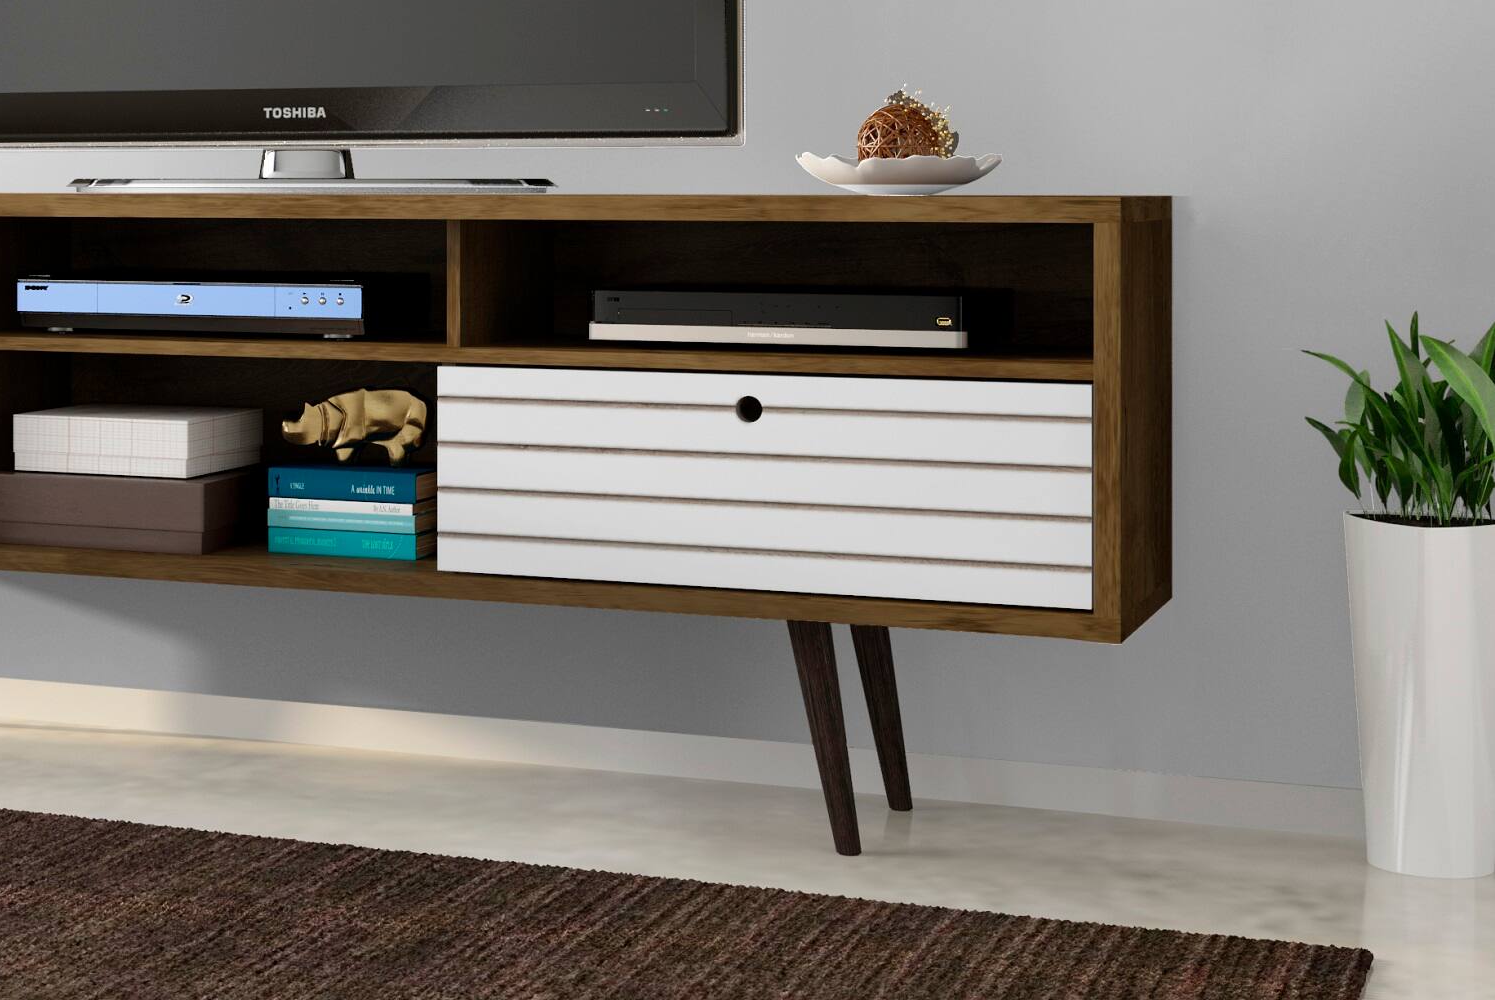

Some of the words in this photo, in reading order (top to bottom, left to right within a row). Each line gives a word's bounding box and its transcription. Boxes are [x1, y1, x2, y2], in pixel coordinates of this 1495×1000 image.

[262, 106, 327, 119] TOSHIBA
[350, 484, 356, 494] A
[375, 486, 382, 495] IN
[382, 486, 395, 496] TIME
[273, 499, 283, 509] The
